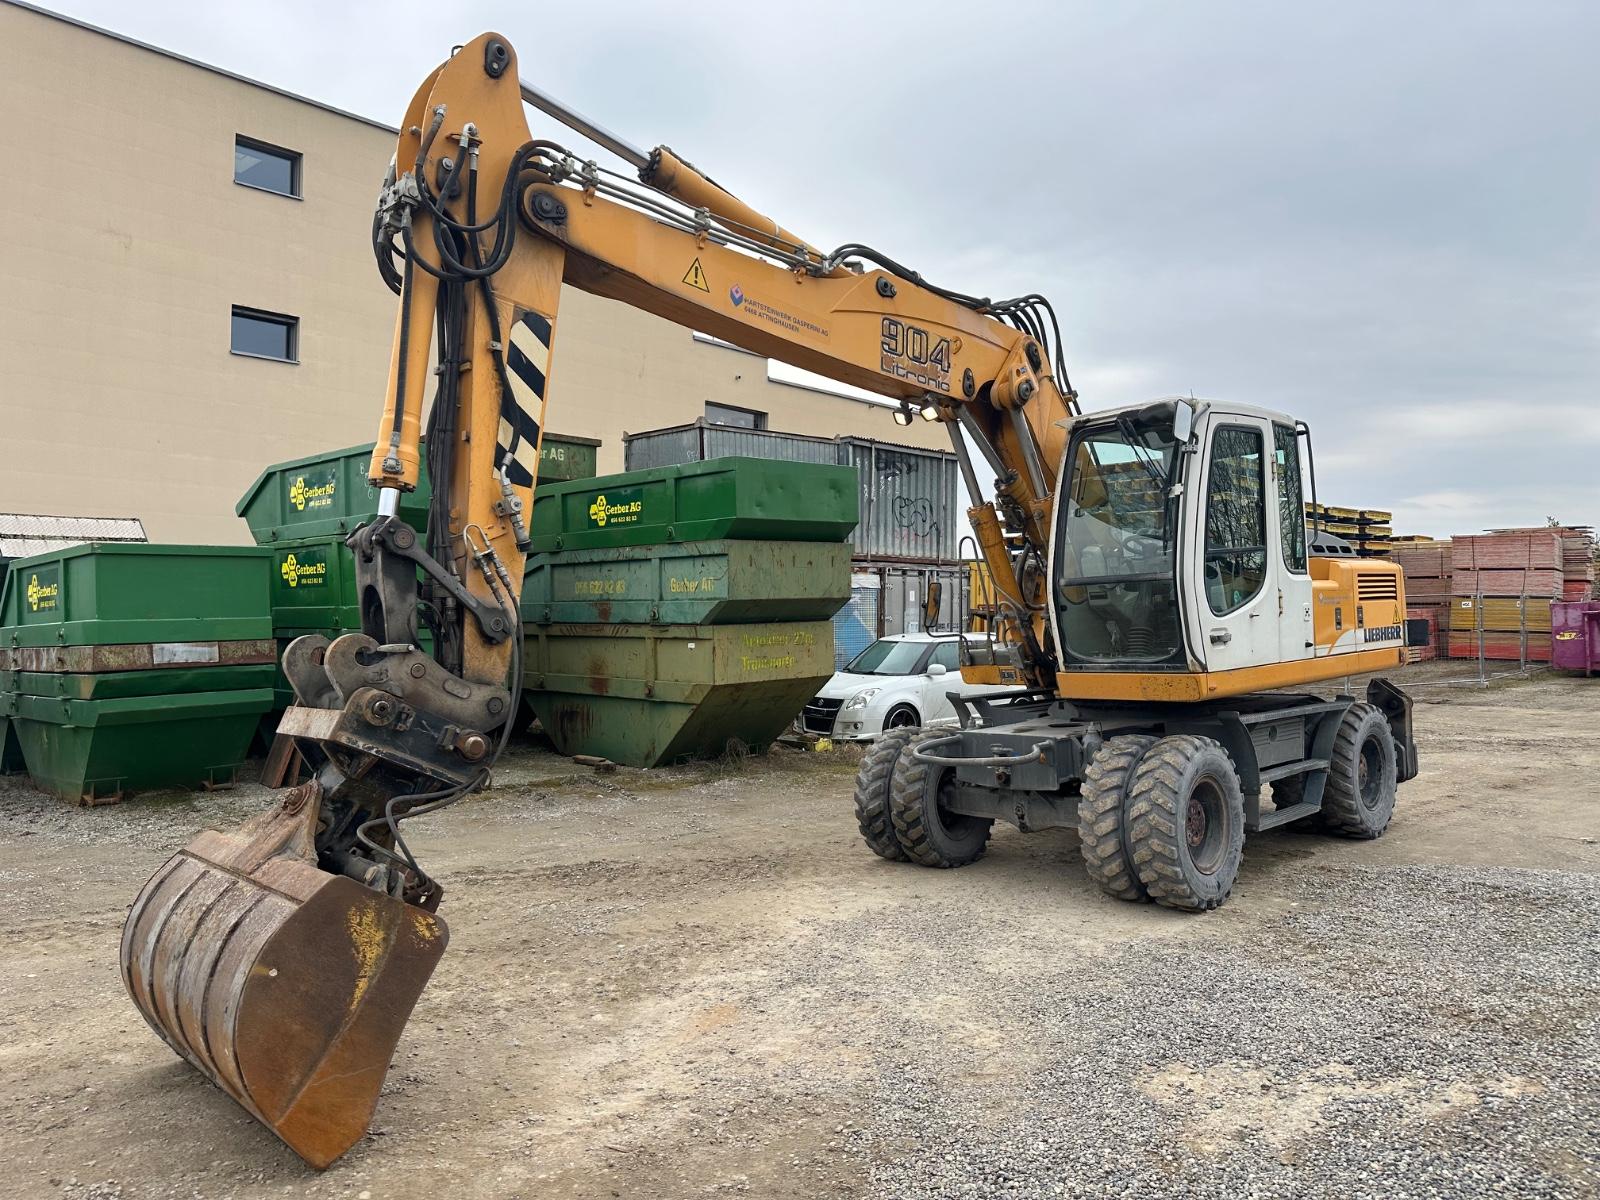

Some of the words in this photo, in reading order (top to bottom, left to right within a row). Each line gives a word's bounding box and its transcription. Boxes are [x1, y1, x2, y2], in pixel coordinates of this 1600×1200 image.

[881, 316, 950, 373] 904
[881, 356, 950, 392] Litronic
[550, 447, 565, 461] AG
[304, 486, 326, 498] Gerber
[326, 484, 335, 495] AG
[605, 503, 629, 515] Gerber
[630, 501, 641, 512] AG
[296, 564, 316, 575] Gerber
[317, 562, 325, 573] AG
[1364, 625, 1401, 642] LIEBHERR
